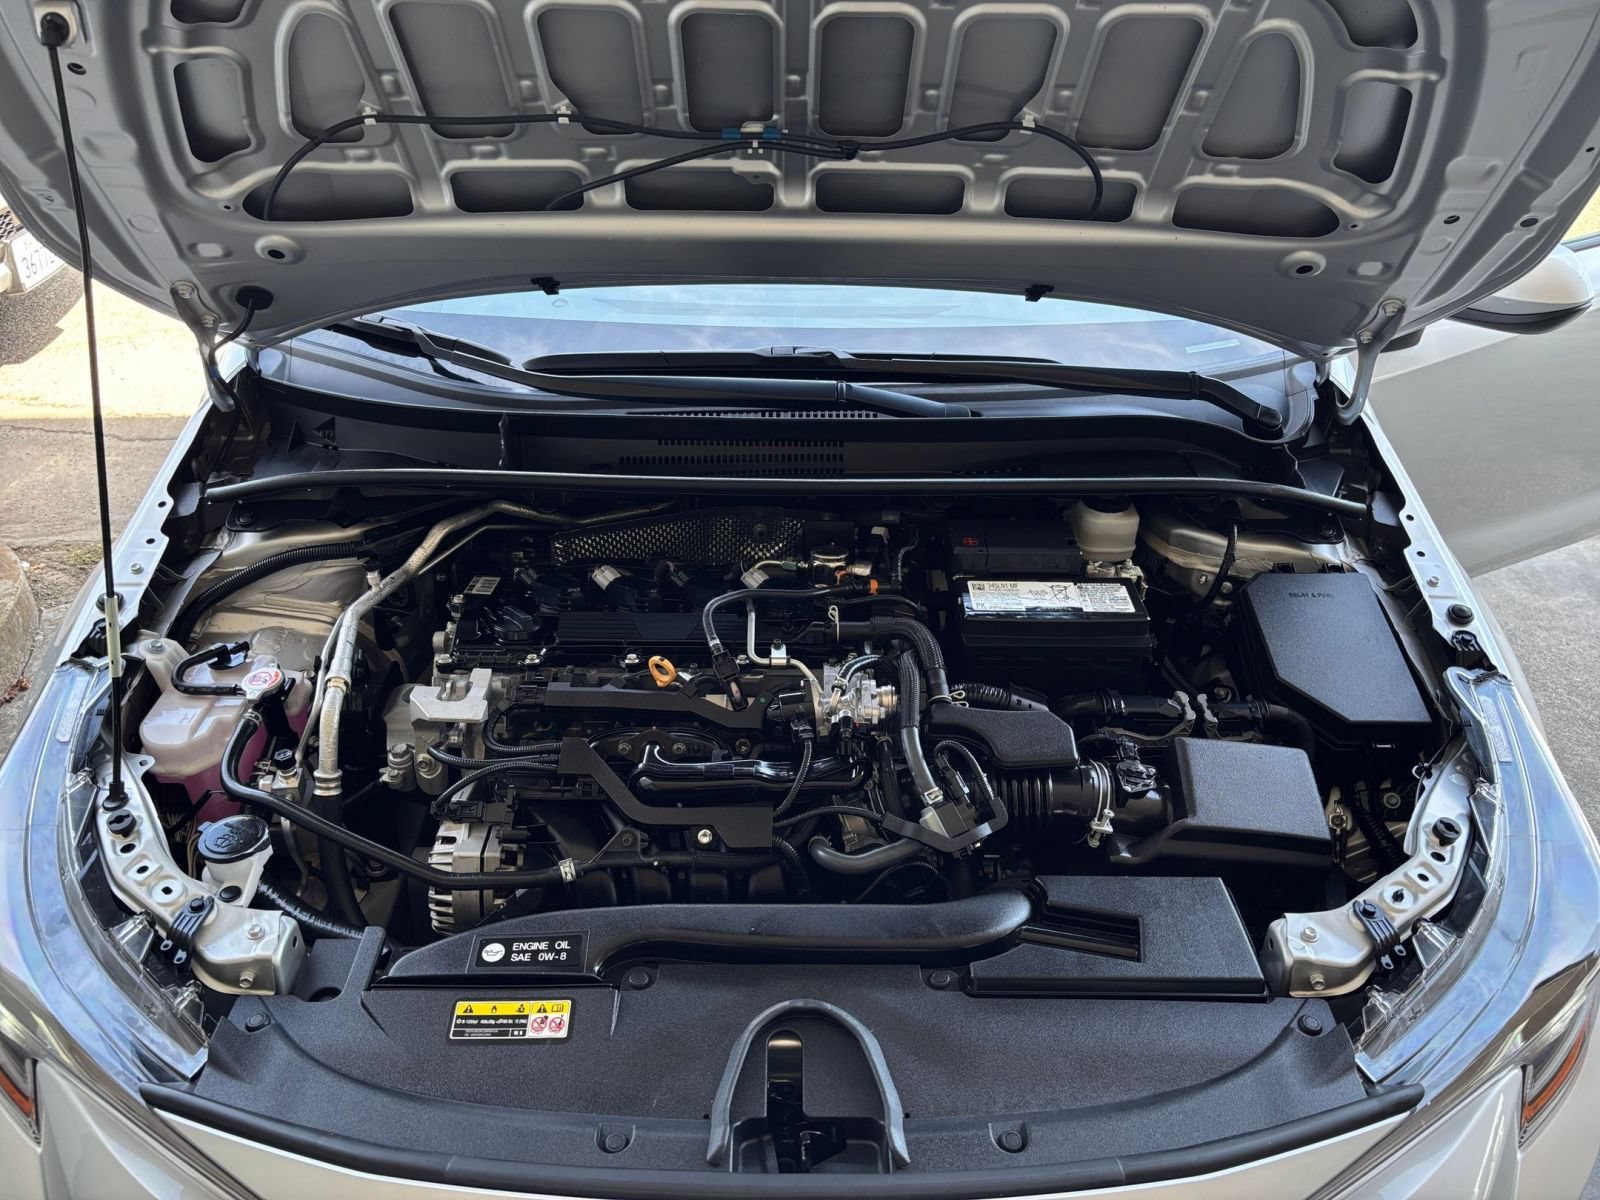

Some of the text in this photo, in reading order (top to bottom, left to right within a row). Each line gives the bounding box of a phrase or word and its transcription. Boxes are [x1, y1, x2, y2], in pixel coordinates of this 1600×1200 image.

[512, 941, 571, 951] ENGINE OIL
[510, 952, 566, 962] SAE 0W-8
